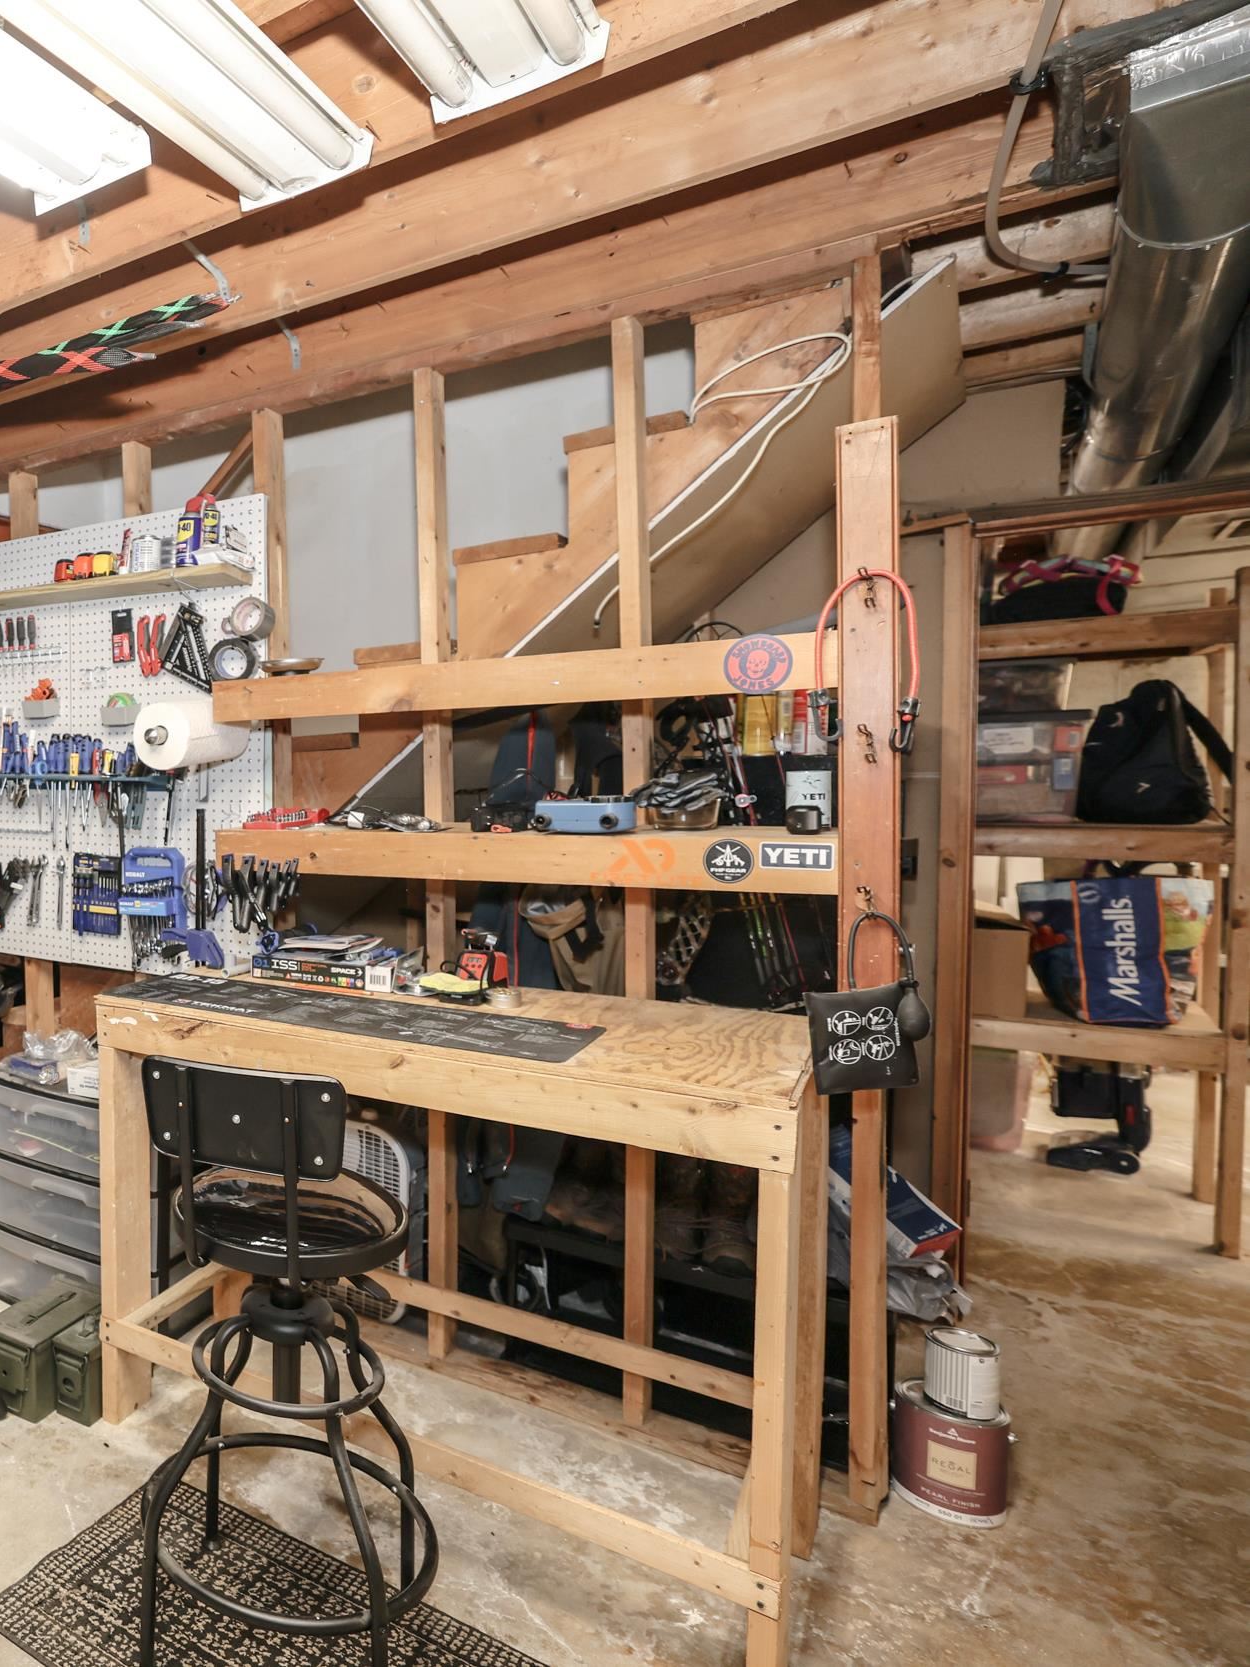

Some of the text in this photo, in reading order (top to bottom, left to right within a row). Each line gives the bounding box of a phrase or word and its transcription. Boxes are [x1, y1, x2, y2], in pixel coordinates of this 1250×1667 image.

[801, 792, 826, 801] YETI
[764, 847, 828, 866] YETI
[1102, 897, 1143, 1006] Marshalls
[271, 959, 298, 971] ISS
[331, 967, 356, 975] SPACE
[169, 973, 228, 985] AR-15
